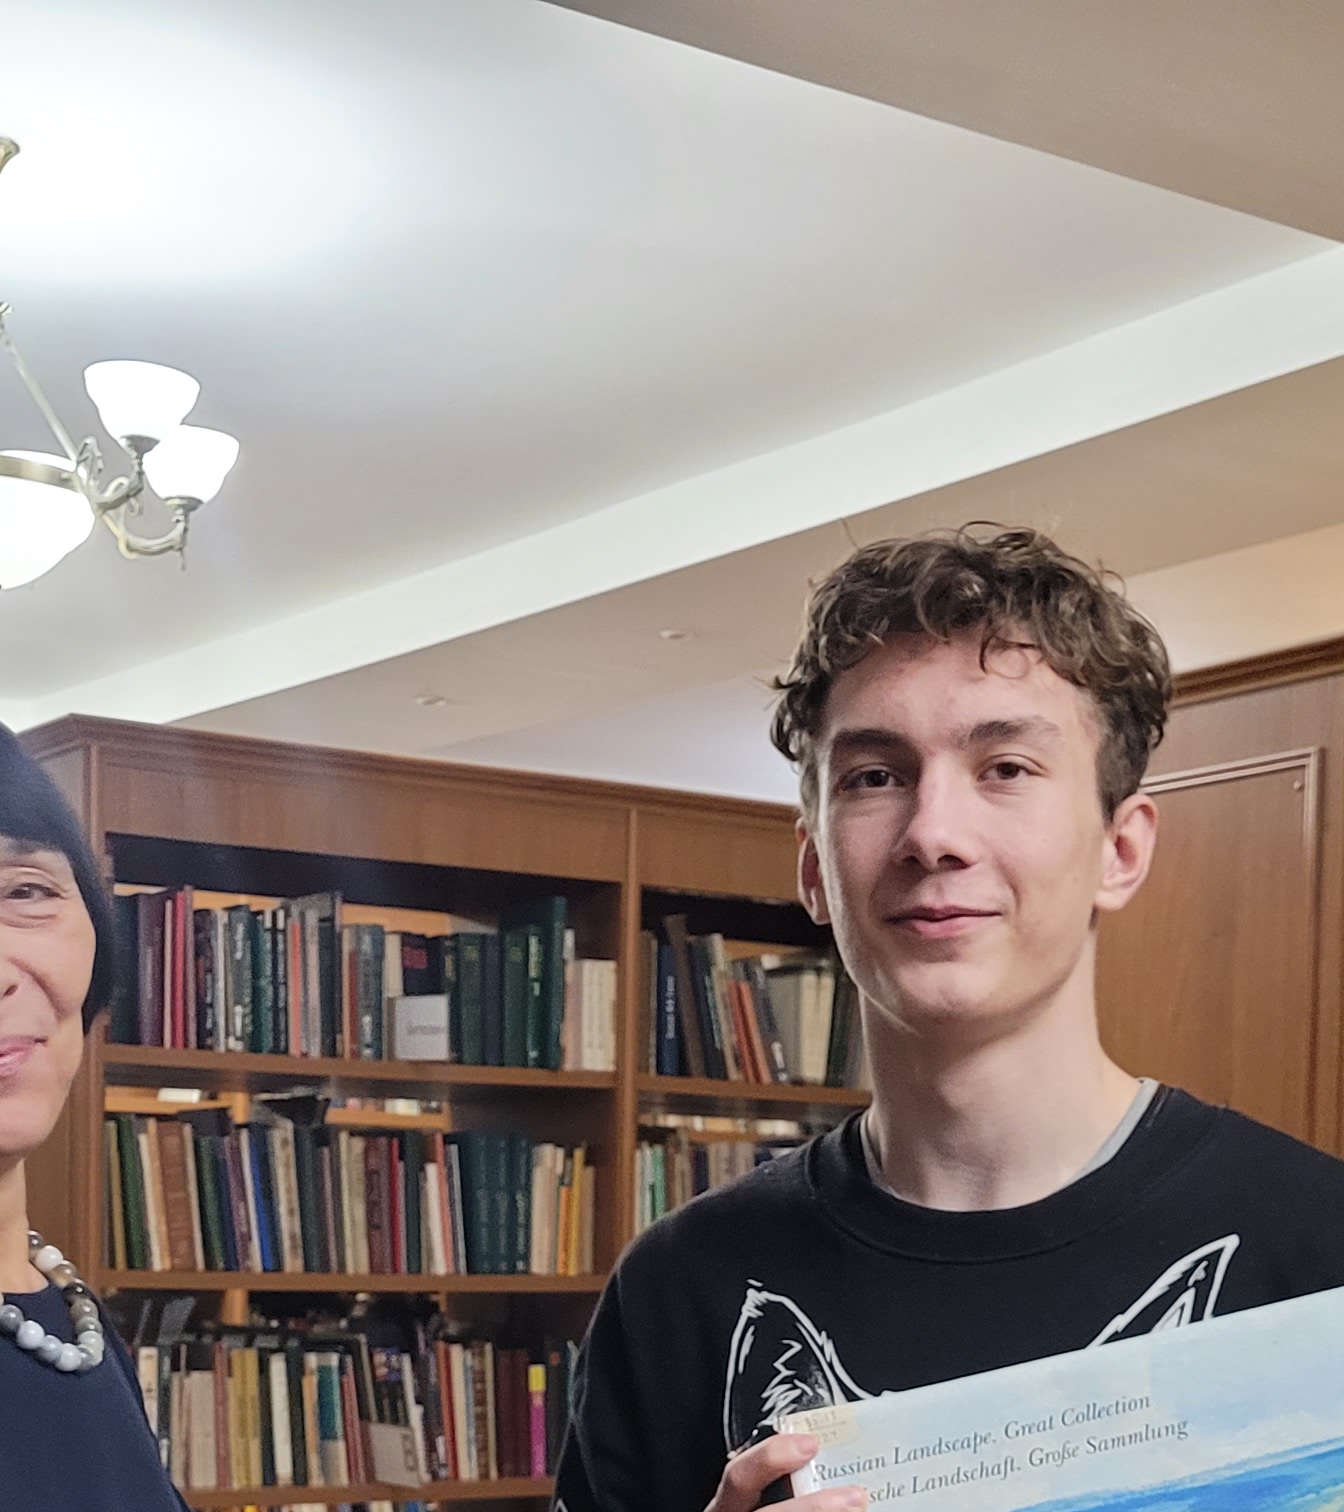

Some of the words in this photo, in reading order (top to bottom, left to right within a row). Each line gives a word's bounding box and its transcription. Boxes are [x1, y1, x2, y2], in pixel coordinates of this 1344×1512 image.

[813, 1455, 887, 1483] Russian
[894, 1429, 997, 1465] Landscape.
[1004, 1415, 1054, 1440] Great
[1061, 1396, 1151, 1427] Collection
[1029, 1440, 1080, 1468] Große
[1086, 1419, 1189, 1455] Sammlung
